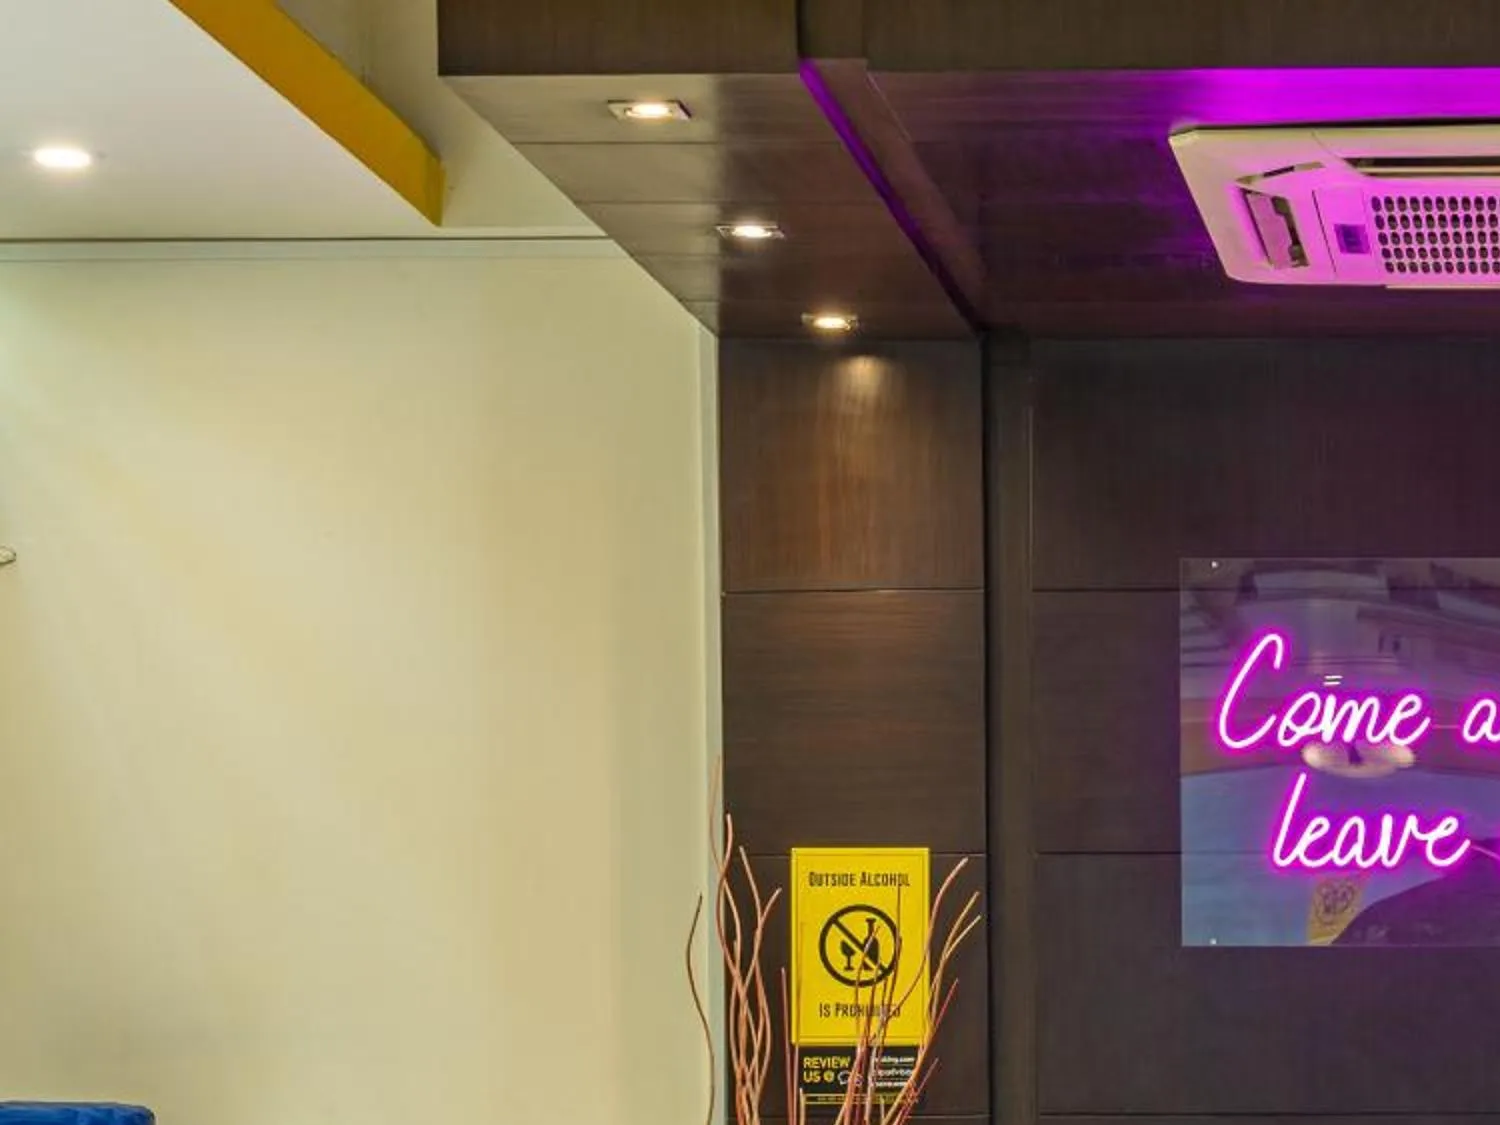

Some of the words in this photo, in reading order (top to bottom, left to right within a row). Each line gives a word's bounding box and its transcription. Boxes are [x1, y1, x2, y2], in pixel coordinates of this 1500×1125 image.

[1217, 631, 1431, 751] Come
[1271, 771, 1472, 870] leave
[803, 1056, 851, 1069] REVIEW
[803, 1069, 821, 1083] US
